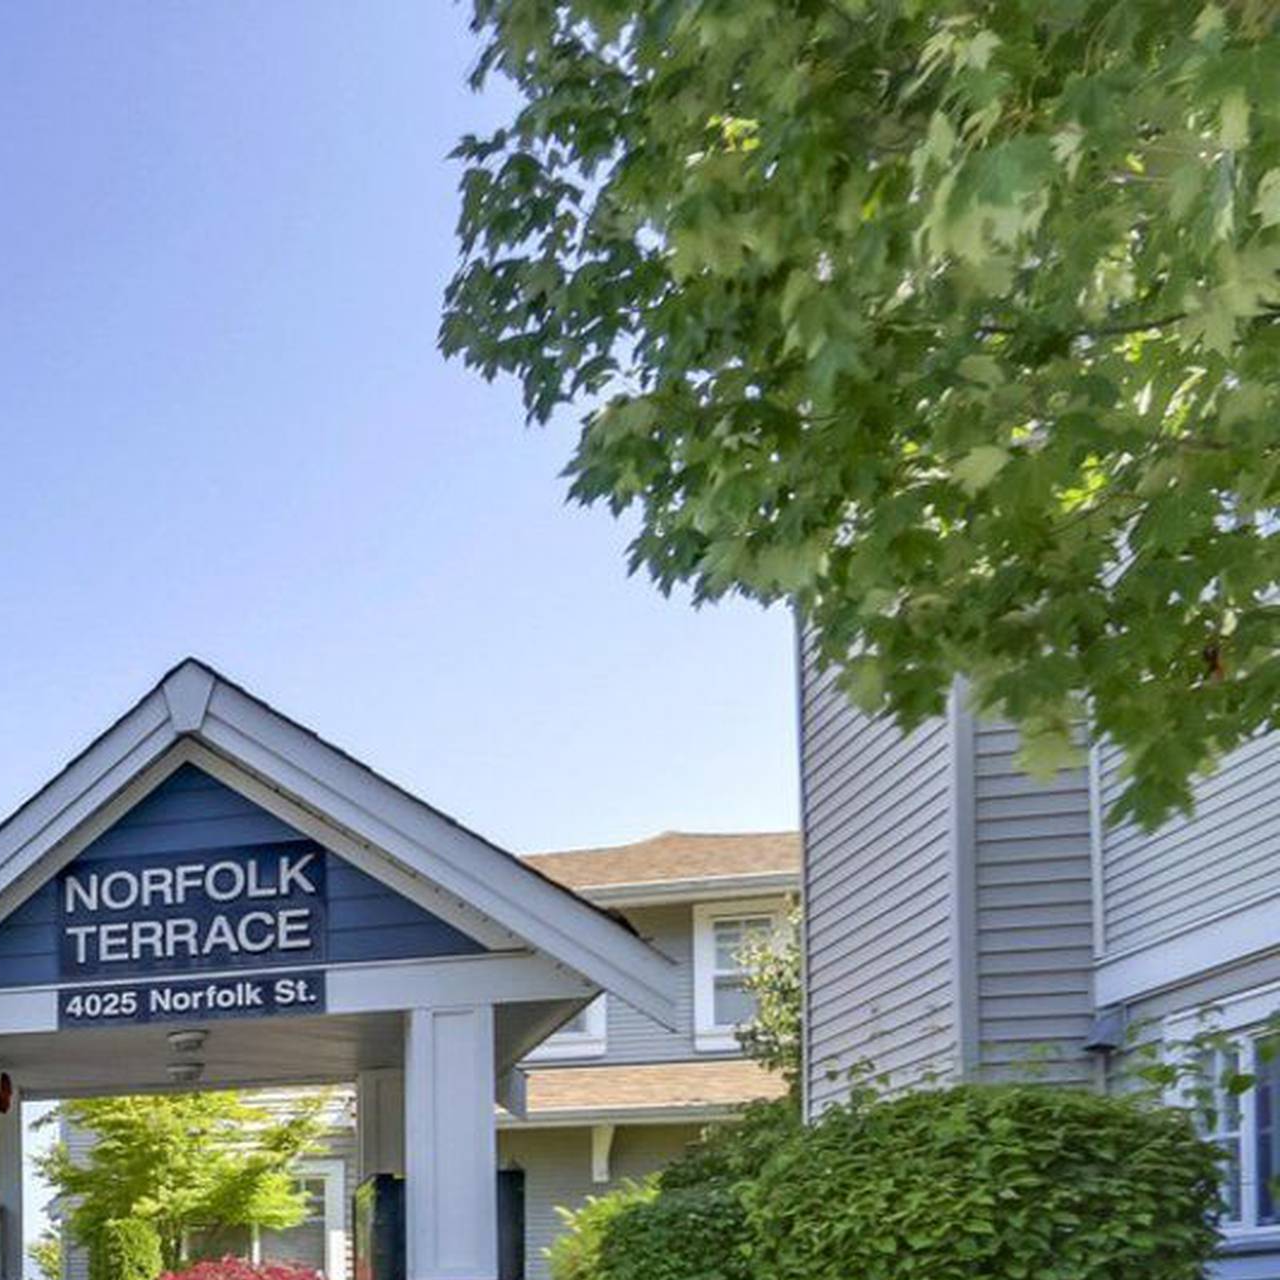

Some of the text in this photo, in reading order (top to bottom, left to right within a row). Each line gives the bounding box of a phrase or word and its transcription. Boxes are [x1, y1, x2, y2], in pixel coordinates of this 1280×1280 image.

[65, 853, 315, 913] NORFOLK
[66, 908, 311, 964] TERRACE
[66, 979, 316, 1018] 4025 Norfolk St.
